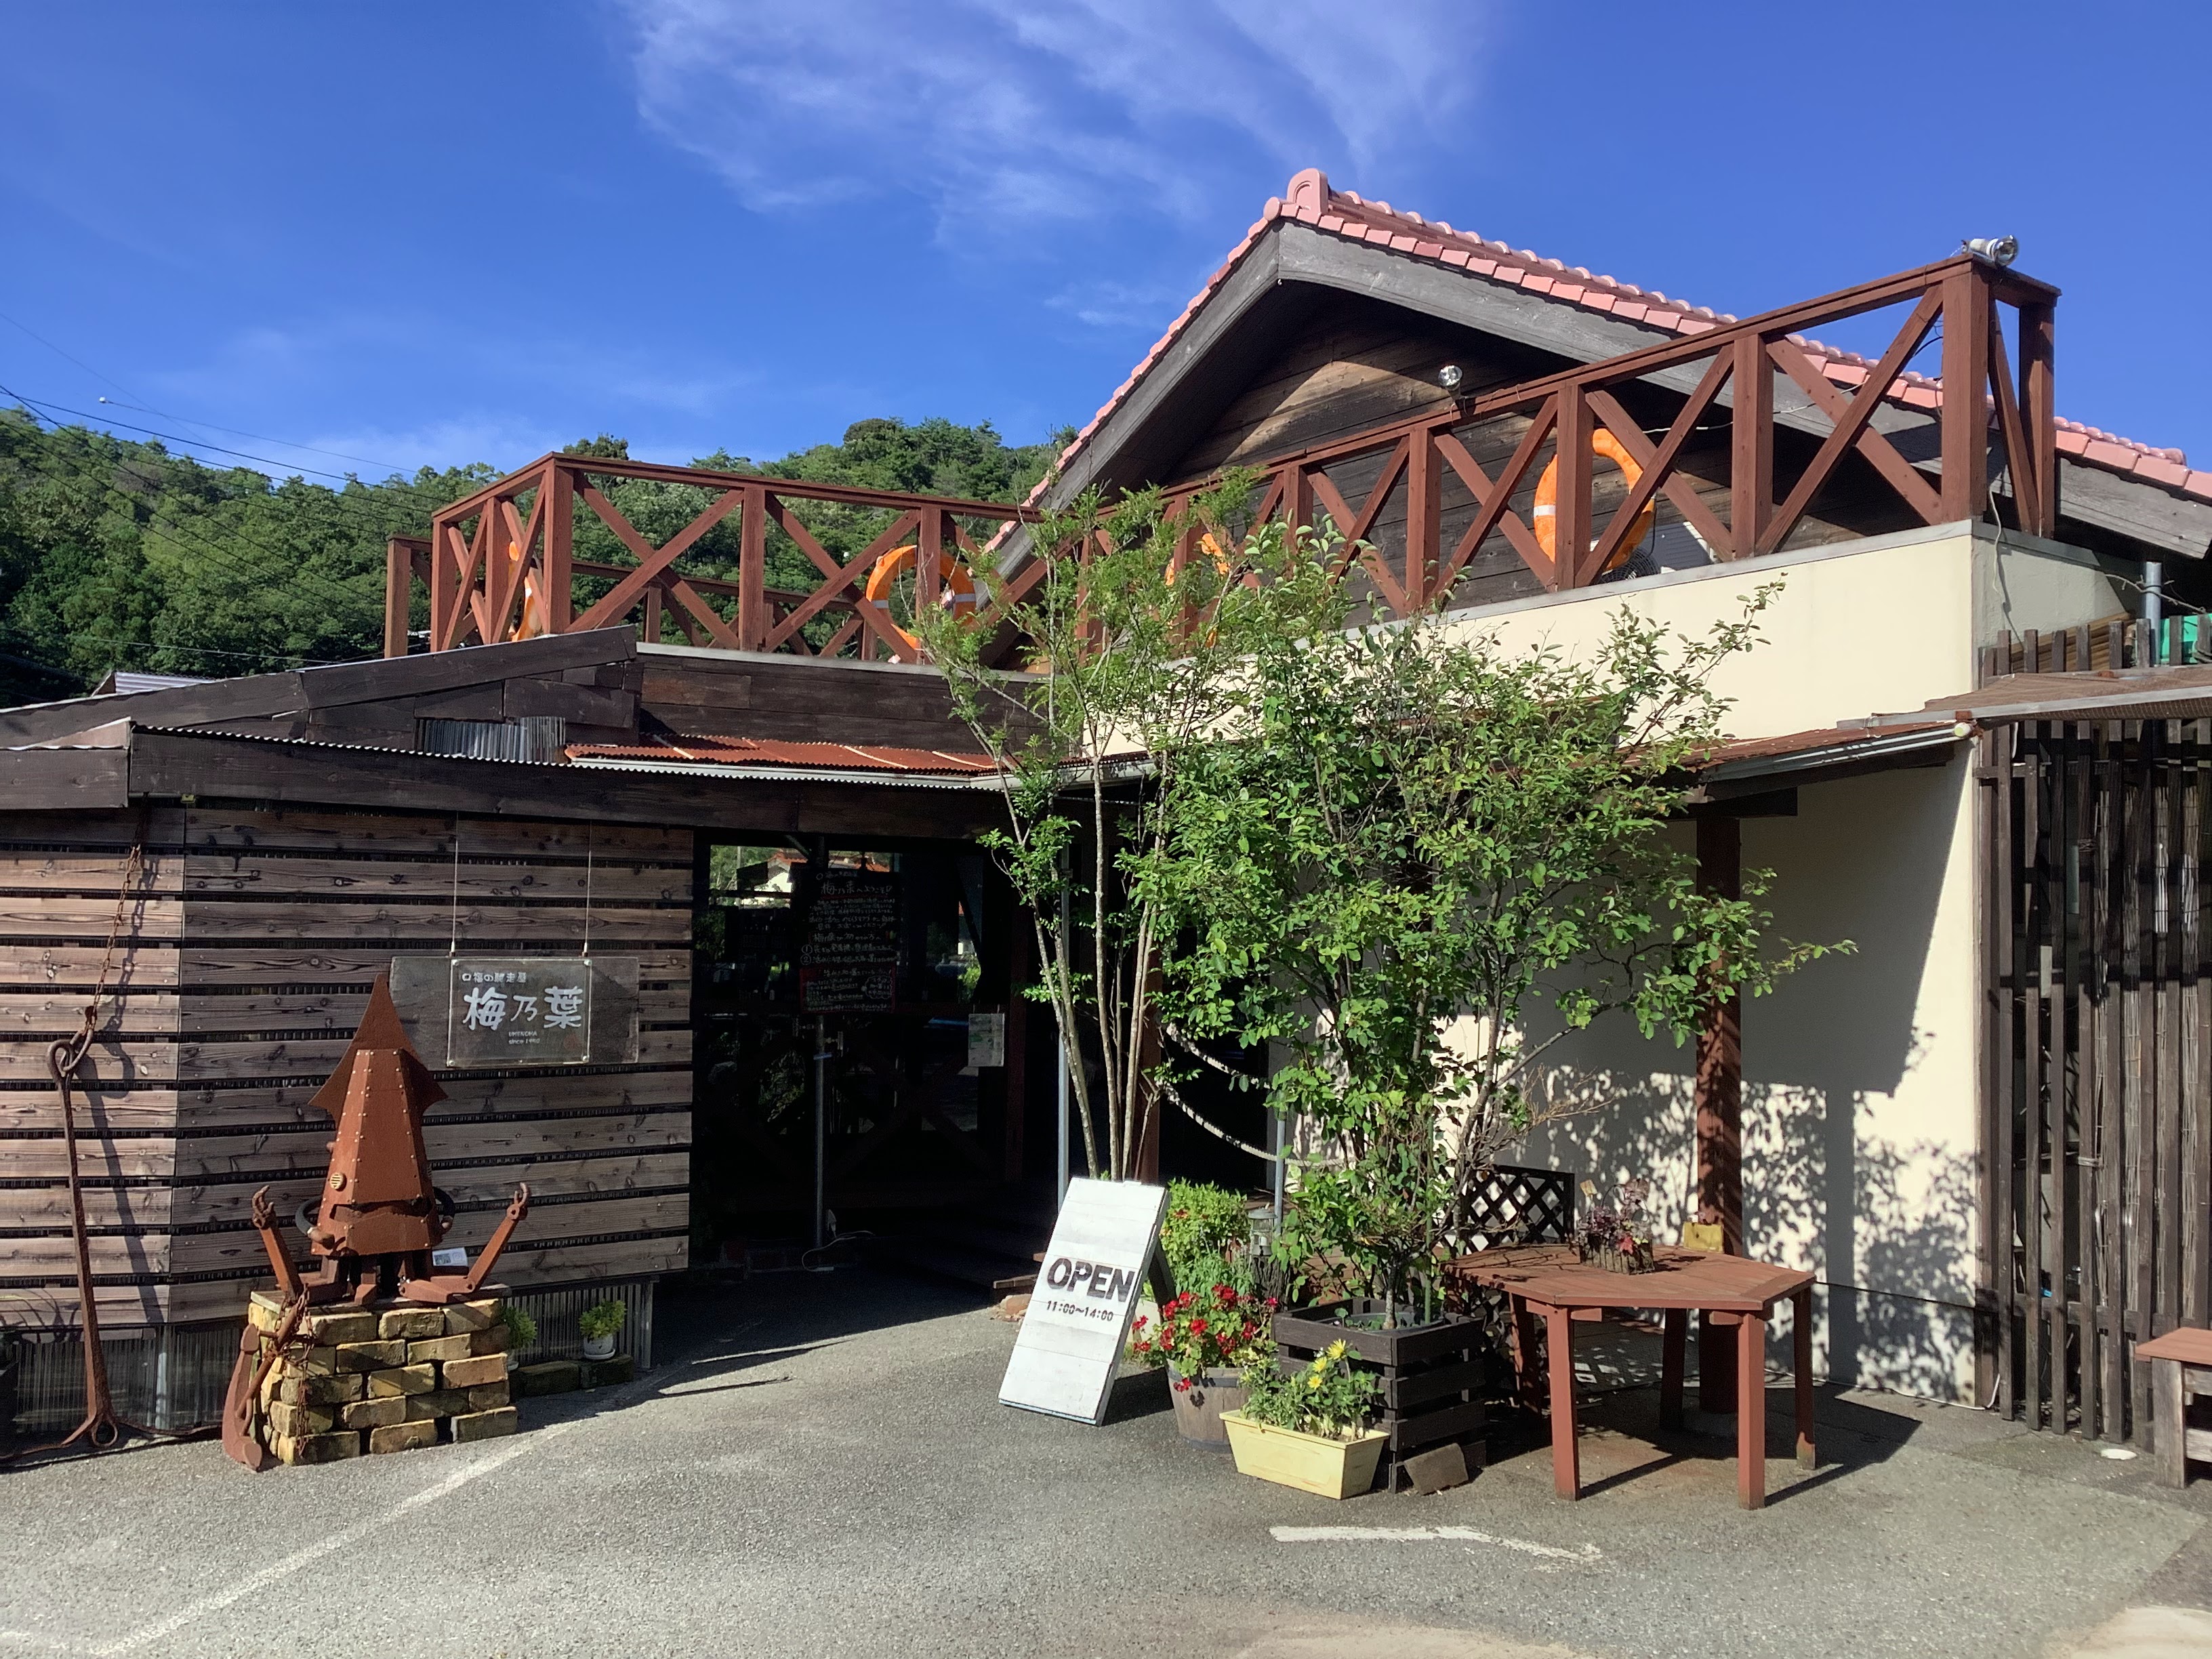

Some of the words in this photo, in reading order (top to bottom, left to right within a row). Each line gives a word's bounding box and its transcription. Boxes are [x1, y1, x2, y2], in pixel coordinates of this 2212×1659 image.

[462, 985, 583, 1031] 梅乃葉
[1046, 1258, 1136, 1303] OPEN
